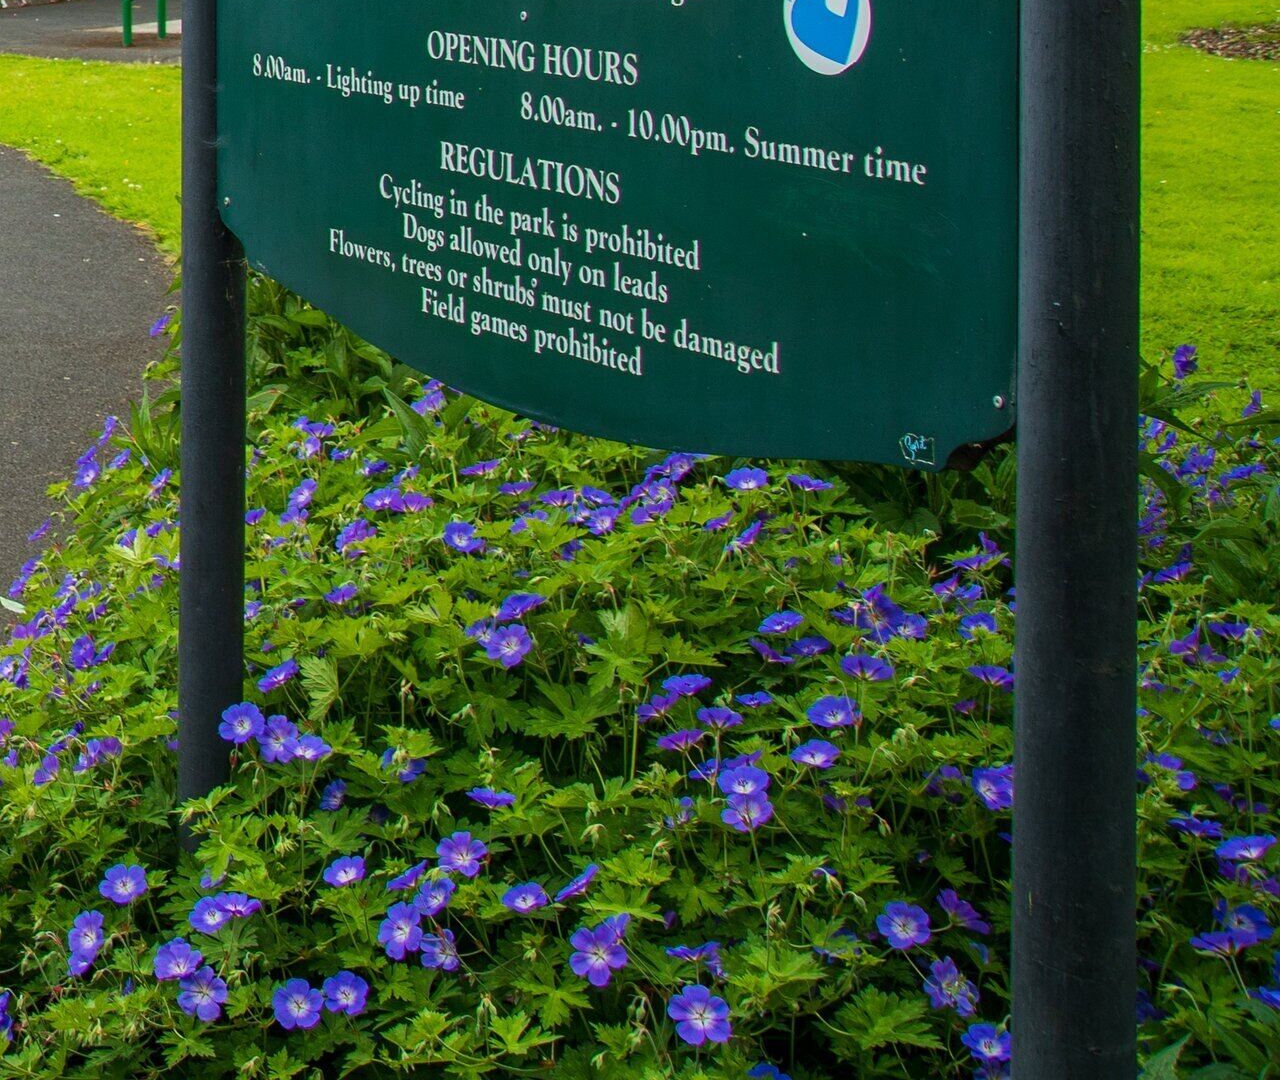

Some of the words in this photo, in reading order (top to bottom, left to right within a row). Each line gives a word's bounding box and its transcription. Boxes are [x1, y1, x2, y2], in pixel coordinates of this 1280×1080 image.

[252, 53, 311, 84] 8.00am.
[326, 63, 393, 105] Lighting
[398, 83, 421, 108] up
[425, 79, 465, 109] time
[427, 30, 536, 72] OPENING
[542, 43, 638, 86] HOURS
[440, 141, 620, 204] REGULATIONS
[520, 91, 603, 132] 8.00am.
[628, 109, 735, 156] 10.00pm.
[744, 126, 854, 173] Summer
[865, 146, 927, 185] time
[379, 173, 444, 219] Cycling
[450, 188, 468, 218] in
[475, 194, 504, 226] the
[510, 207, 556, 238] park
[562, 212, 579, 243] is
[585, 224, 701, 271] prohibited
[402, 212, 445, 252] Dogs
[449, 225, 522, 267] allowed
[528, 247, 572, 286] only
[578, 265, 606, 288] on
[614, 261, 668, 304] leads
[329, 228, 396, 272] Flowers,
[402, 254, 443, 282] trees
[447, 269, 468, 289] or
[473, 266, 538, 307] shrubs
[542, 294, 592, 323] must
[599, 309, 635, 335] not
[642, 307, 666, 343] be
[674, 318, 780, 374] damaged
[421, 286, 465, 324] Field
[471, 310, 528, 342] games
[534, 327, 643, 376] prohibited
